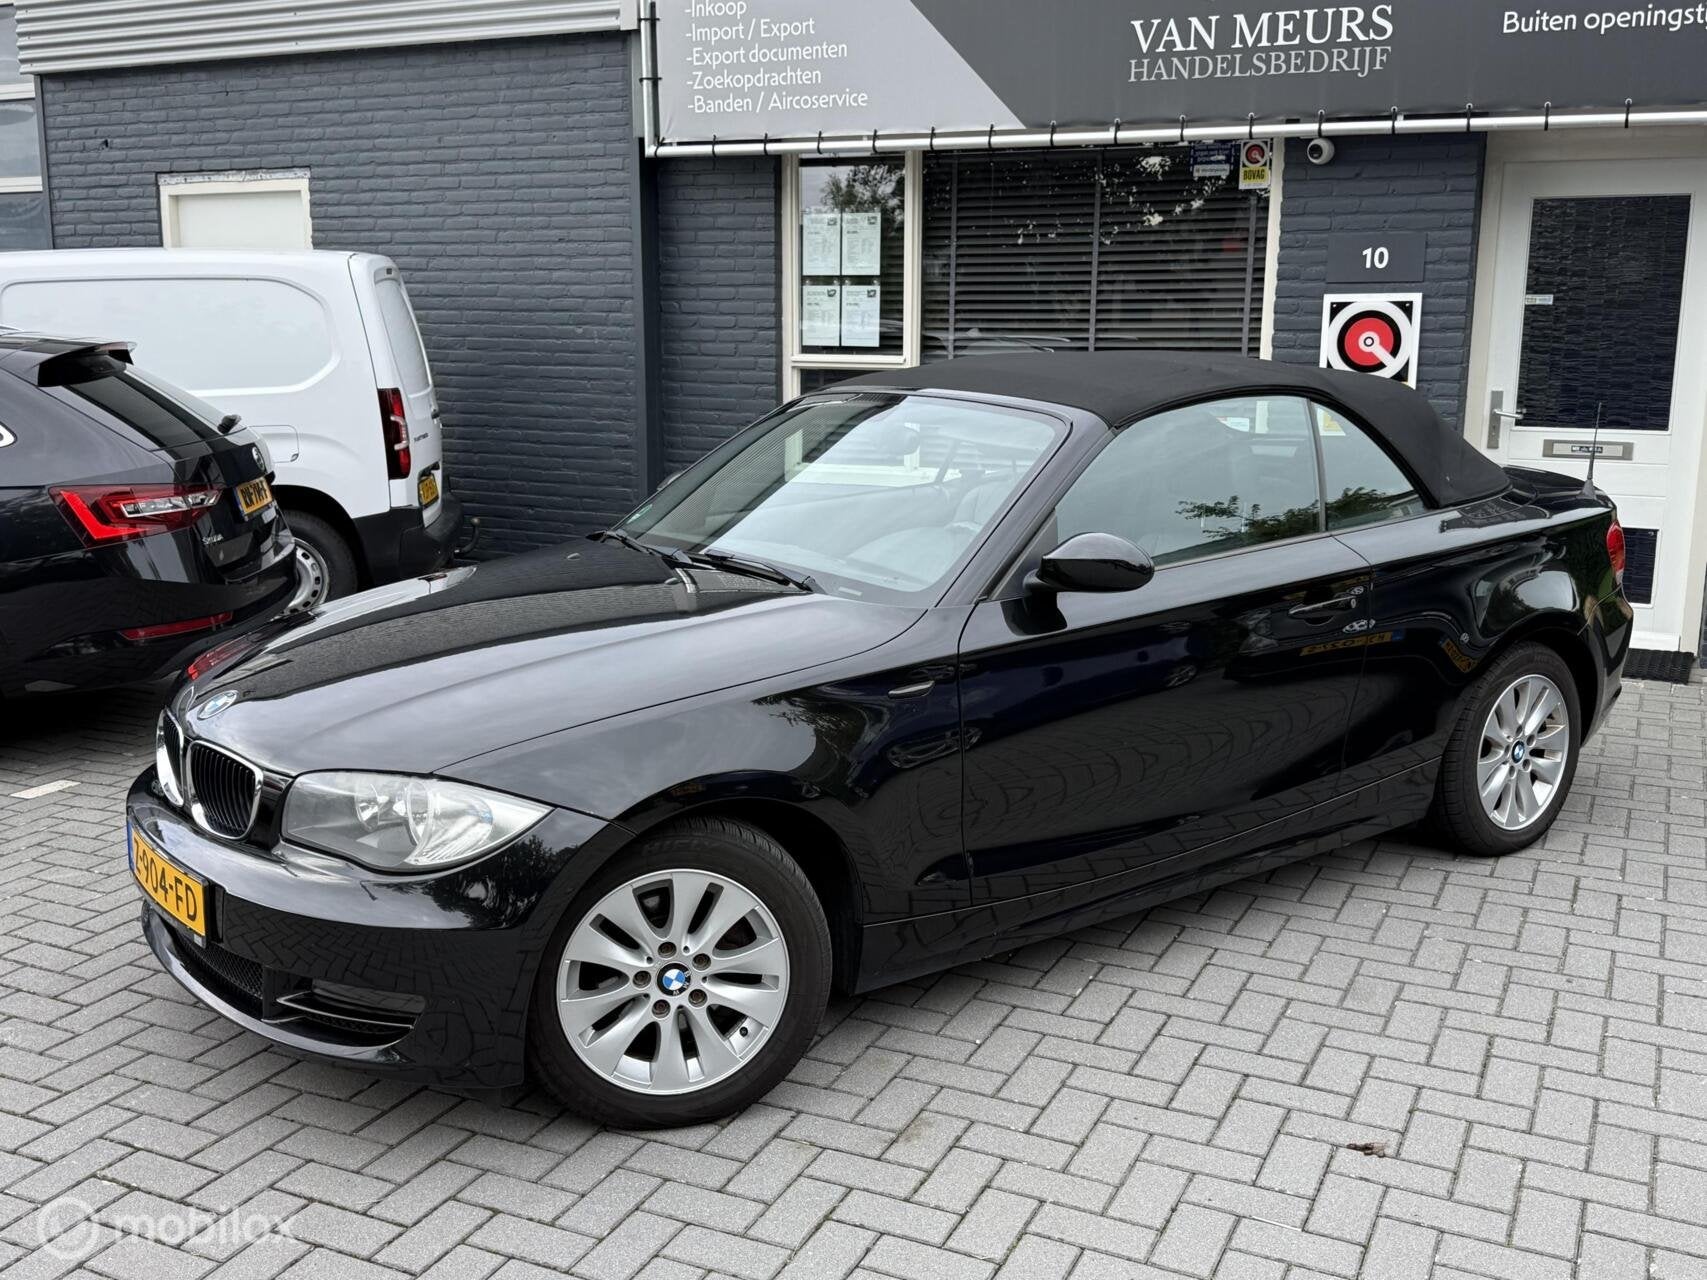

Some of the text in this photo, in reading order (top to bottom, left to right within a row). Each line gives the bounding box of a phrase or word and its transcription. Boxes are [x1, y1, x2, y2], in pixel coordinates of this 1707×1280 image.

[684, 0, 747, 19] -Inkoop
[1503, 4, 1707, 35] Buiten openingst
[685, 17, 815, 45] -Import / Export
[1130, 4, 1394, 54] VAN MEURS
[686, 42, 848, 70] -Export documenten
[1127, 46, 1392, 82] HANDELSBEDRIJF
[686, 66, 821, 92] -Zoekopdrachten
[687, 88, 868, 113] -Banden / Aircoservice
[1243, 169, 1265, 181] BOVAG
[1362, 246, 1389, 269] 10
